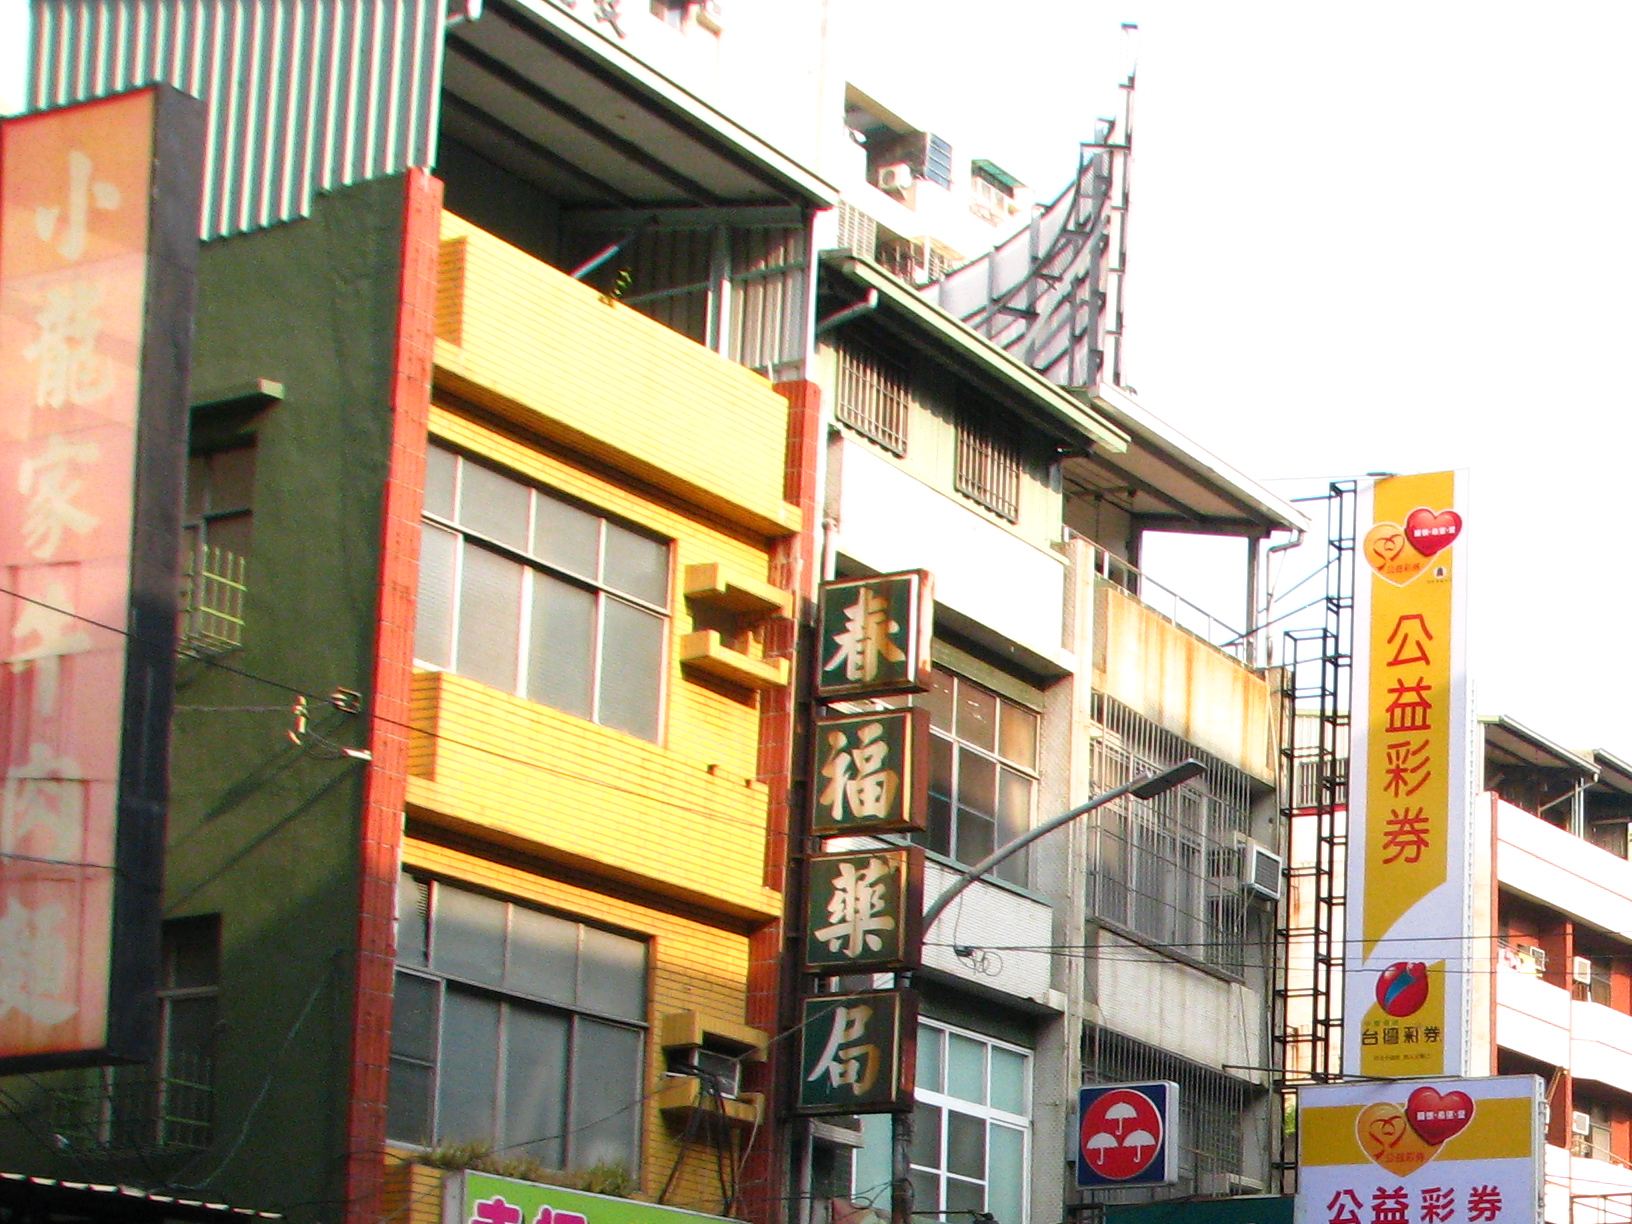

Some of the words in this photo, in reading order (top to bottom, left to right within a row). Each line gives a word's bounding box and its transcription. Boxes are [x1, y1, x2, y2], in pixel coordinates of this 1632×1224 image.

[808, 587, 906, 1097] 春福藥局
[1382, 613, 1434, 866] 公益彩券
